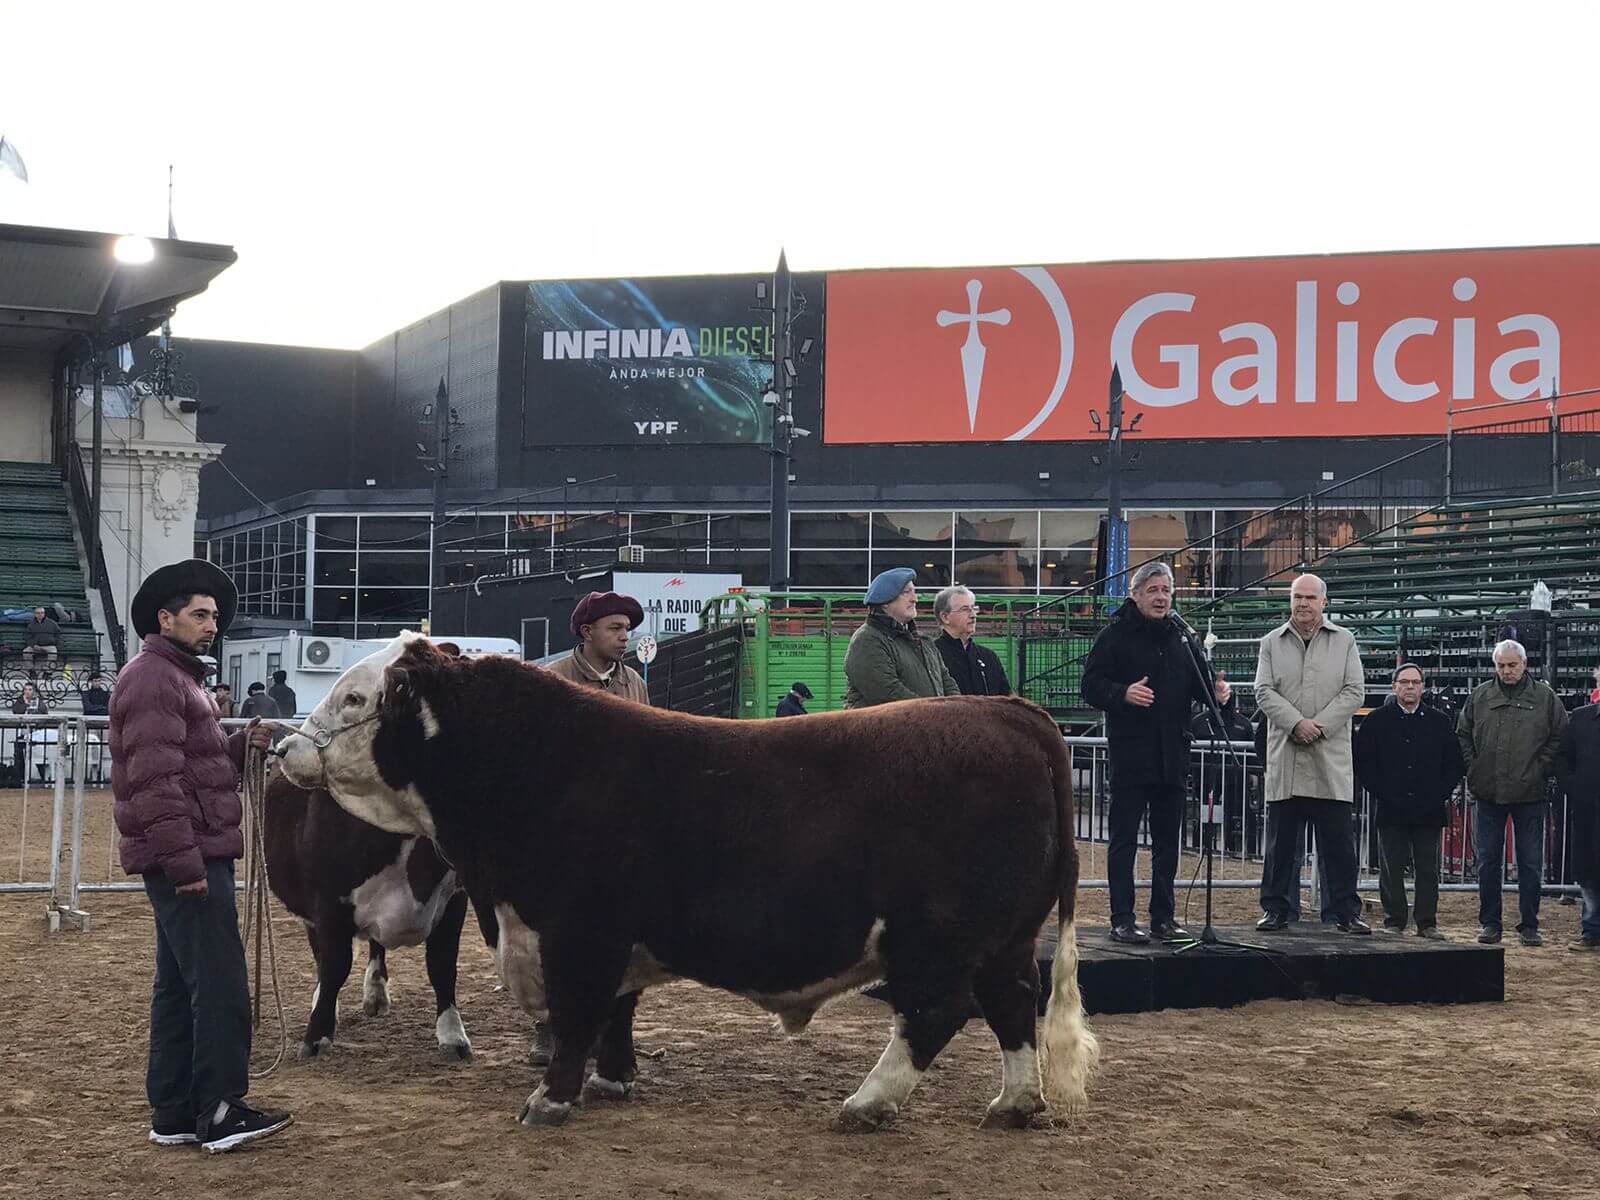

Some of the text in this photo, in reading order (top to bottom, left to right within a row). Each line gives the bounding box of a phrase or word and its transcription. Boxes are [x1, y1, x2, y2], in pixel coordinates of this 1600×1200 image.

[542, 326, 774, 360] INFINIA DIESEL
[1110, 277, 1562, 408] Galicia
[609, 367, 705, 379] ANDA MEJOR
[633, 421, 679, 435] YPF
[648, 599, 702, 614] LA RADIO
[664, 618, 687, 632] QUE
